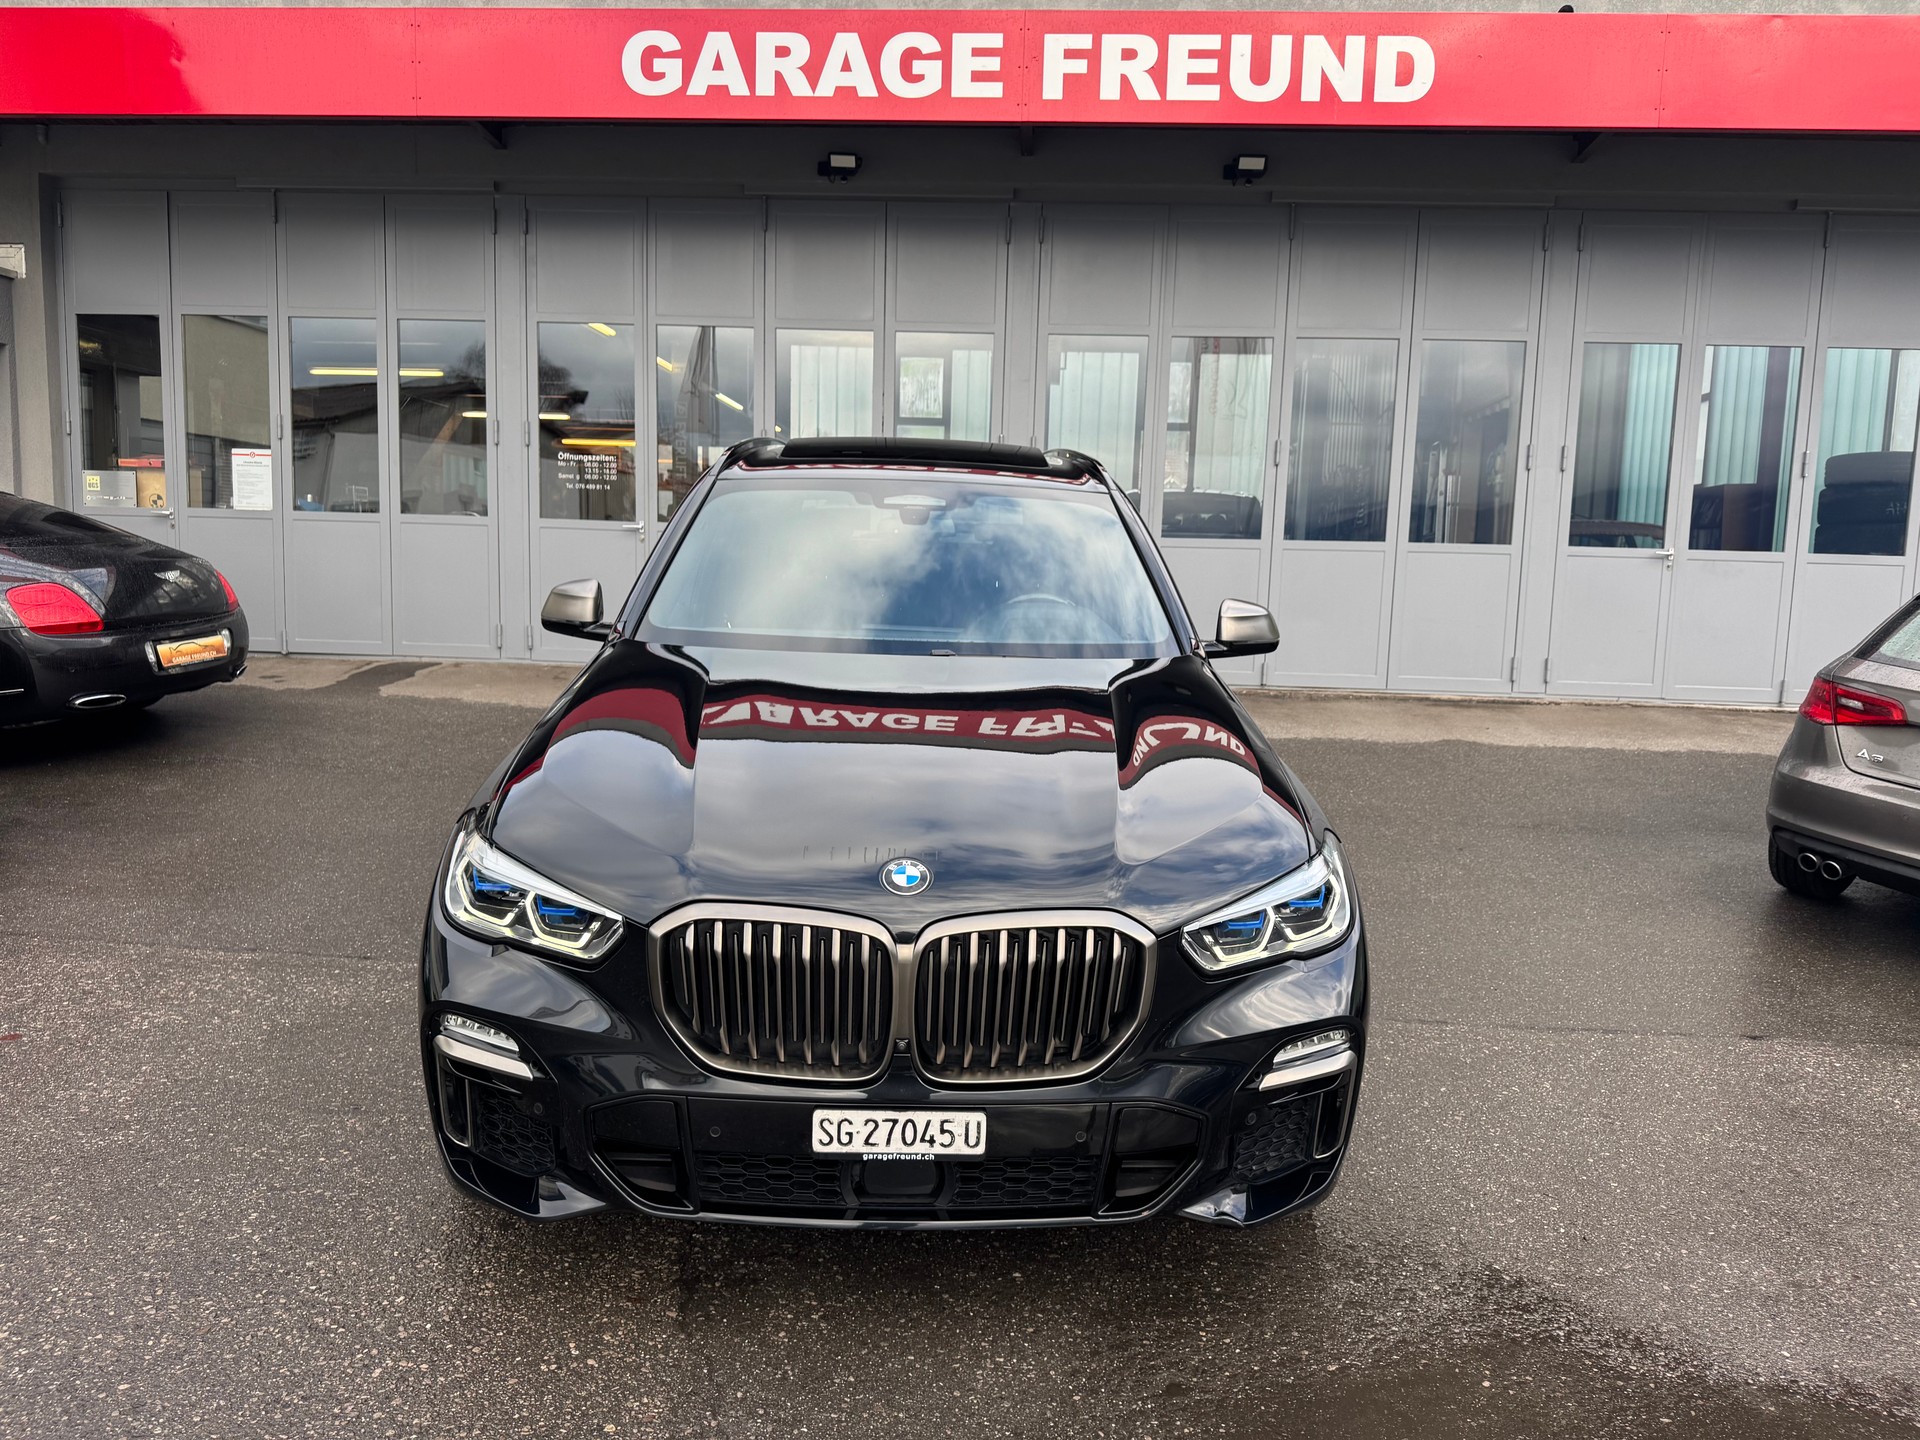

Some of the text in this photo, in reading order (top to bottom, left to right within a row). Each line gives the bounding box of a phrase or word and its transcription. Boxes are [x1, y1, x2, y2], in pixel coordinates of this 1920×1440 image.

[622, 30, 1435, 102] GARAGE FREUND
[557, 452, 617, 462] Öffnungszeiten:
[862, 1153, 935, 1161] garagefreund.ch
